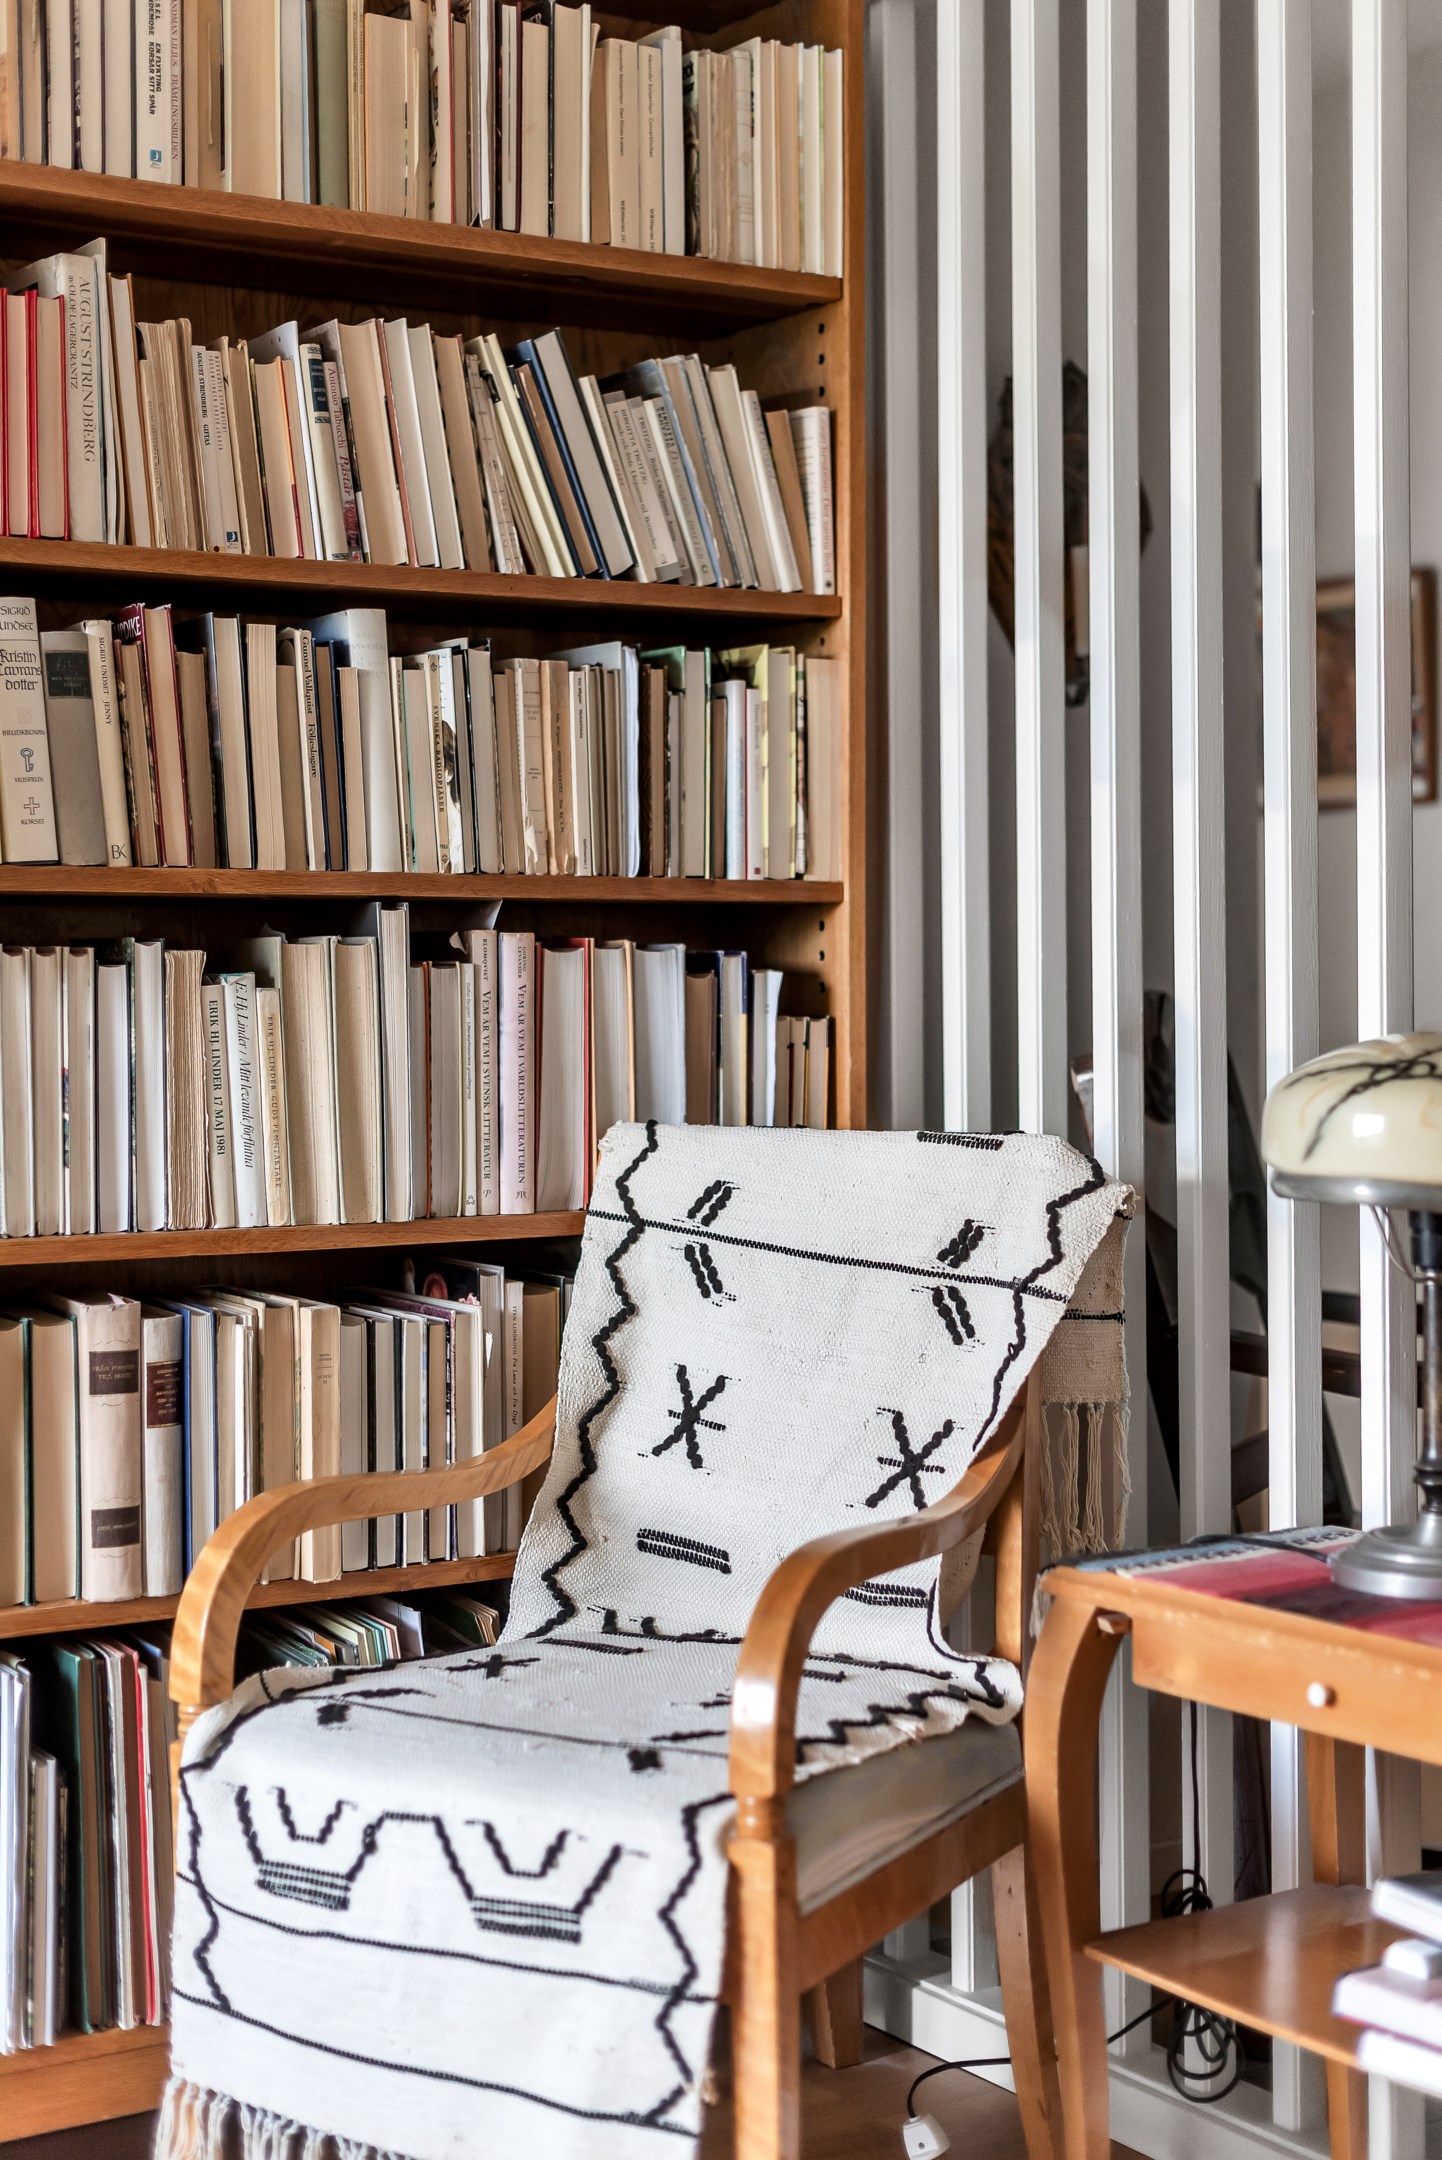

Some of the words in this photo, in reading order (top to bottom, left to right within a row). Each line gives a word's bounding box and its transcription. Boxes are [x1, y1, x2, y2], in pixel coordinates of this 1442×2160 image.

[155, 43, 161, 54] EN
[171, 74, 179, 160] FRÄMLINGSBILDEN
[68, 275, 75, 284] av
[68, 285, 77, 314] OLOF
[79, 276, 92, 349] AUGUST
[69, 314, 78, 390] LAGERCRANTZ
[196, 351, 204, 377] AUGUST
[80, 349, 96, 462] STRINDBERG
[198, 377, 208, 418] STRINDBERG
[327, 368, 339, 406] Antonio
[333, 407, 346, 449] Tabucchi
[203, 424, 211, 447] GIFTAS
[98, 636, 106, 662] SIGRID
[302, 637, 311, 673] Gunnel
[101, 664, 109, 695] UNDSET
[304, 674, 314, 715] Vallquist
[103, 700, 112, 726] JENNY
[307, 723, 317, 778] Följeslagare
[435, 750, 445, 813] RADIOPJÄSER
[235, 981, 246, 994] E.
[518, 984, 527, 1009] VEM
[209, 1000, 219, 1026] ERIK
[233, 995, 248, 1012] Hj.
[482, 990, 492, 1015] VEM
[236, 1013, 249, 1049] Linder
[483, 1017, 491, 1032] ÄR
[518, 1012, 527, 1026] ÄR
[208, 1030, 219, 1046] HJ.
[483, 1034, 491, 1058] VEM
[518, 1029, 526, 1052] VEM
[211, 1049, 222, 1091] LINDER
[239, 1058, 251, 1082] Mitt
[268, 1056, 277, 1091] LINDER
[213, 1095, 223, 1105] 17
[483, 1068, 491, 1108] SVENSK
[240, 1084, 252, 1122] levande
[212, 1109, 224, 1131] MAJ
[518, 1062, 527, 1184] VÄRLDSLITTERATUREN
[215, 1134, 226, 1155] 1981
[240, 1121, 254, 1168] förflutna
[272, 1124, 282, 1188] PENNFÄKTARE
[483, 1111, 491, 1180] LITTERATUR
[511, 1410, 519, 1425] Dygd
